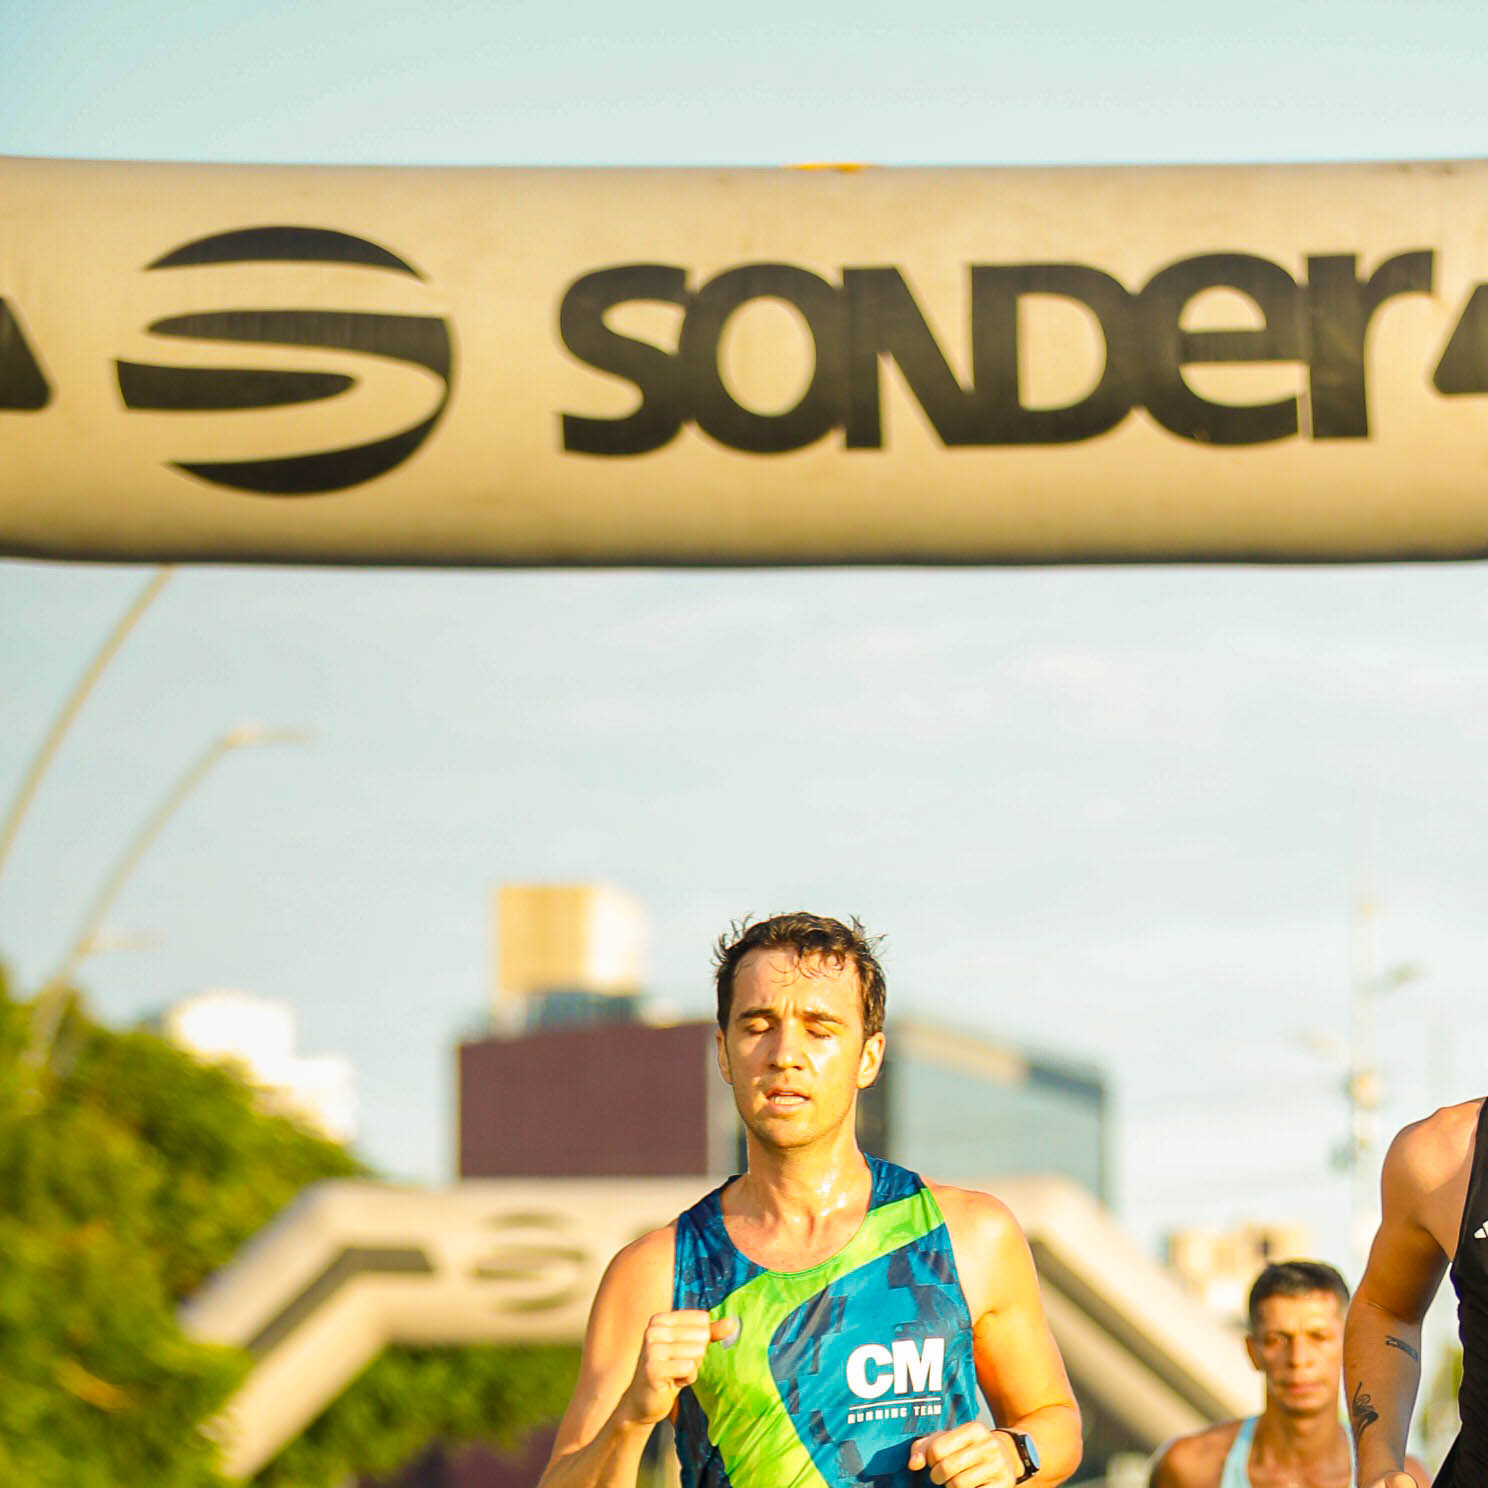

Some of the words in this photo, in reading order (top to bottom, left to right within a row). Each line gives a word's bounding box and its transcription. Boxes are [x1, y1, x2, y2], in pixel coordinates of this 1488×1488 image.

[846, 1336, 944, 1399] CM
[847, 1407, 907, 1424] RUNNING
[913, 1404, 942, 1417] TEAM
